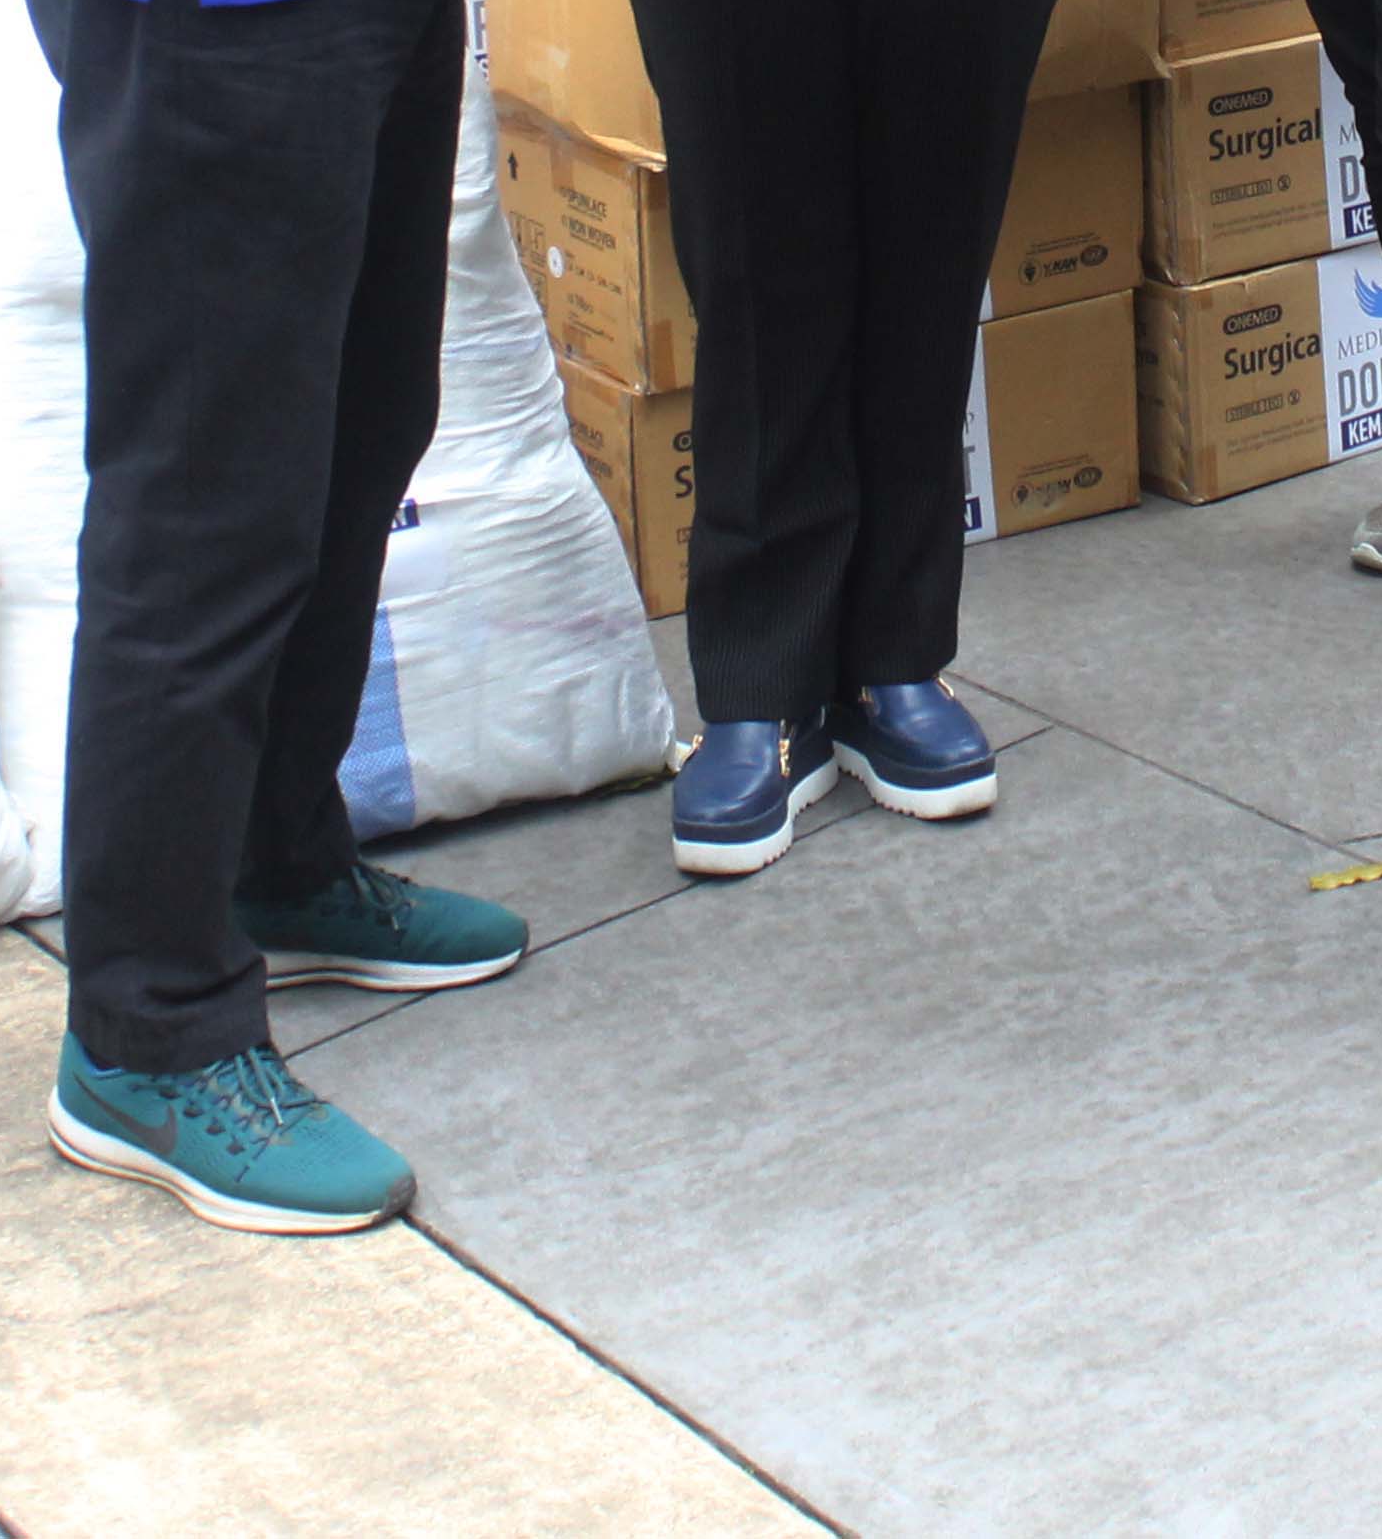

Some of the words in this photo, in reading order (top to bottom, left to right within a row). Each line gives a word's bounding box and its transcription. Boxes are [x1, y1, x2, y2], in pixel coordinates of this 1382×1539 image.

[1212, 90, 1268, 114] ONEMED
[1209, 109, 1322, 161] Surgical
[1227, 306, 1280, 332] ONEMED
